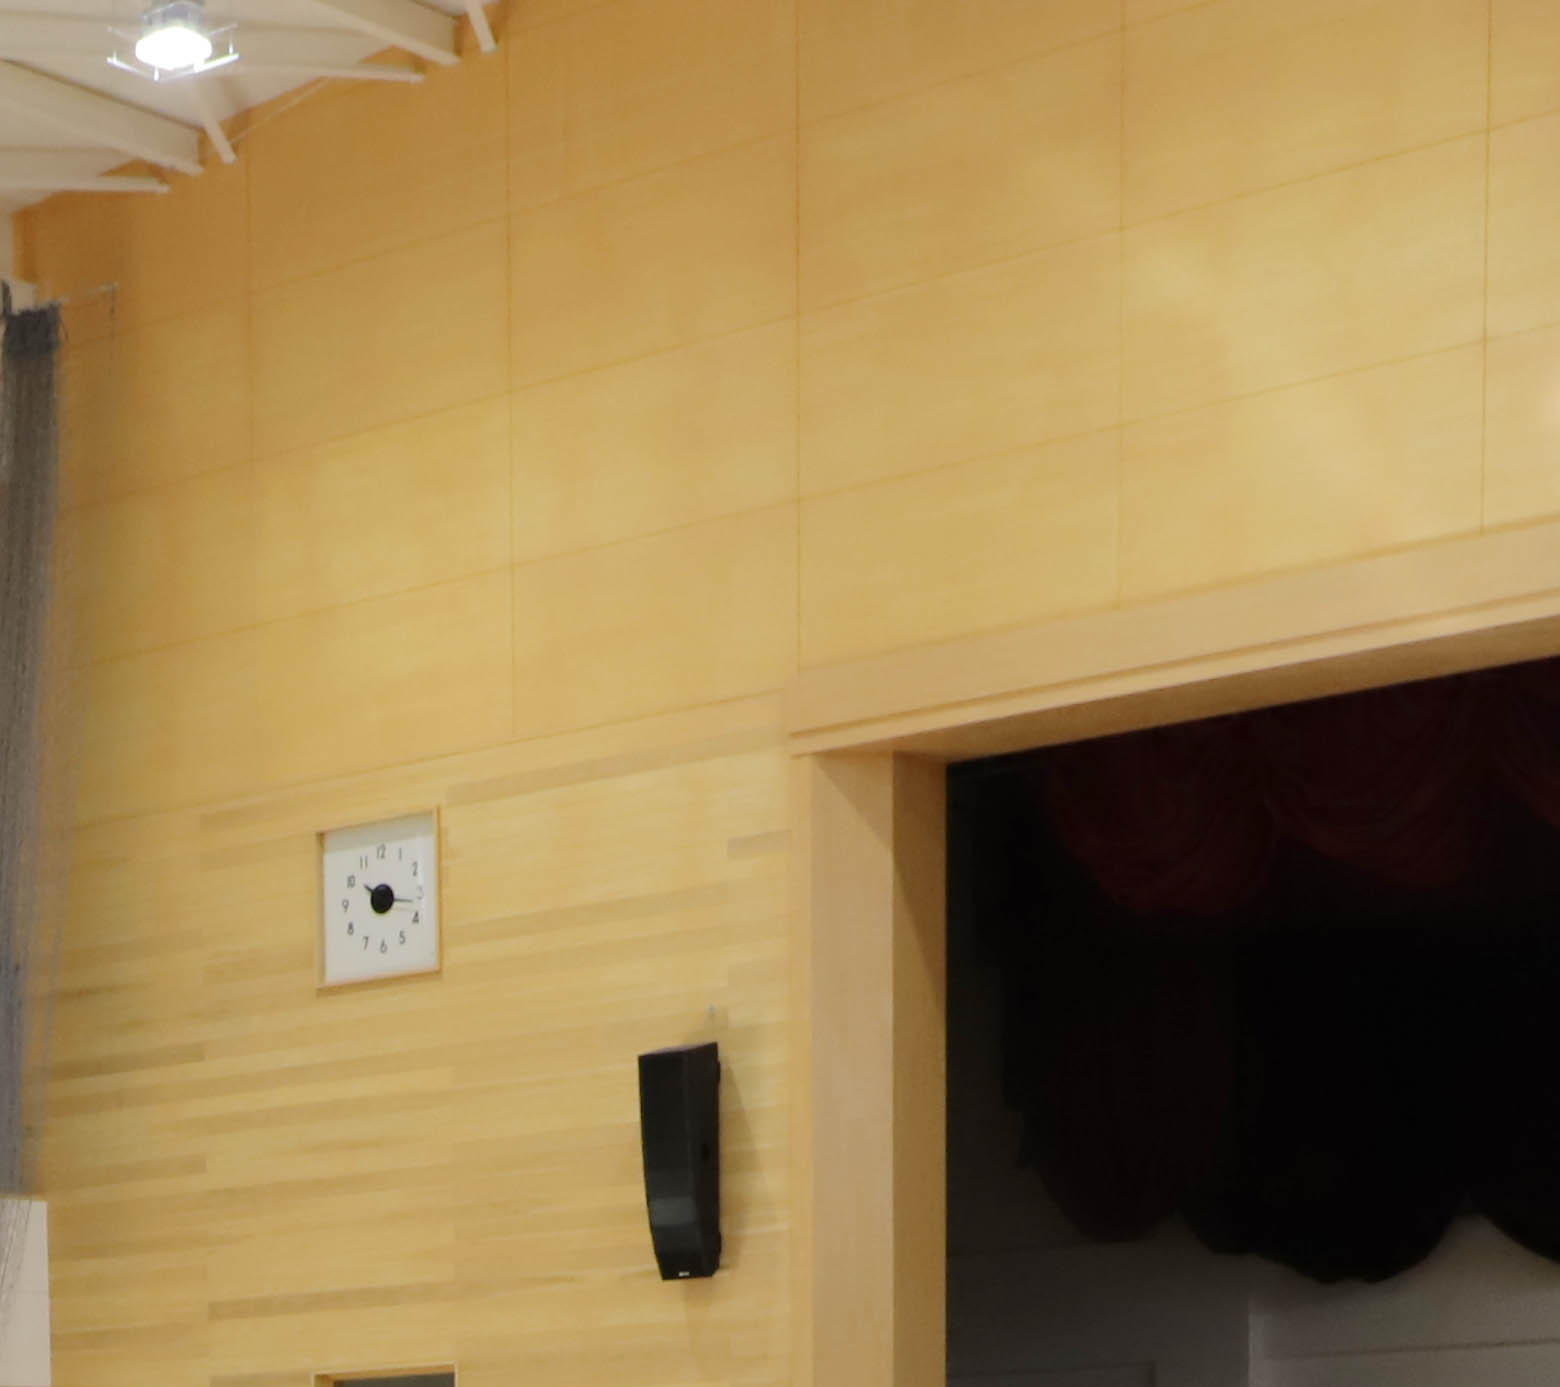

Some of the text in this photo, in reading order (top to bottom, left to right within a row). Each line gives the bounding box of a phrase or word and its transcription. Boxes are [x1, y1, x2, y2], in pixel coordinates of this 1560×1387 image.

[376, 843, 386, 860] 12
[359, 855, 368, 871] 11
[347, 874, 356, 889] 10
